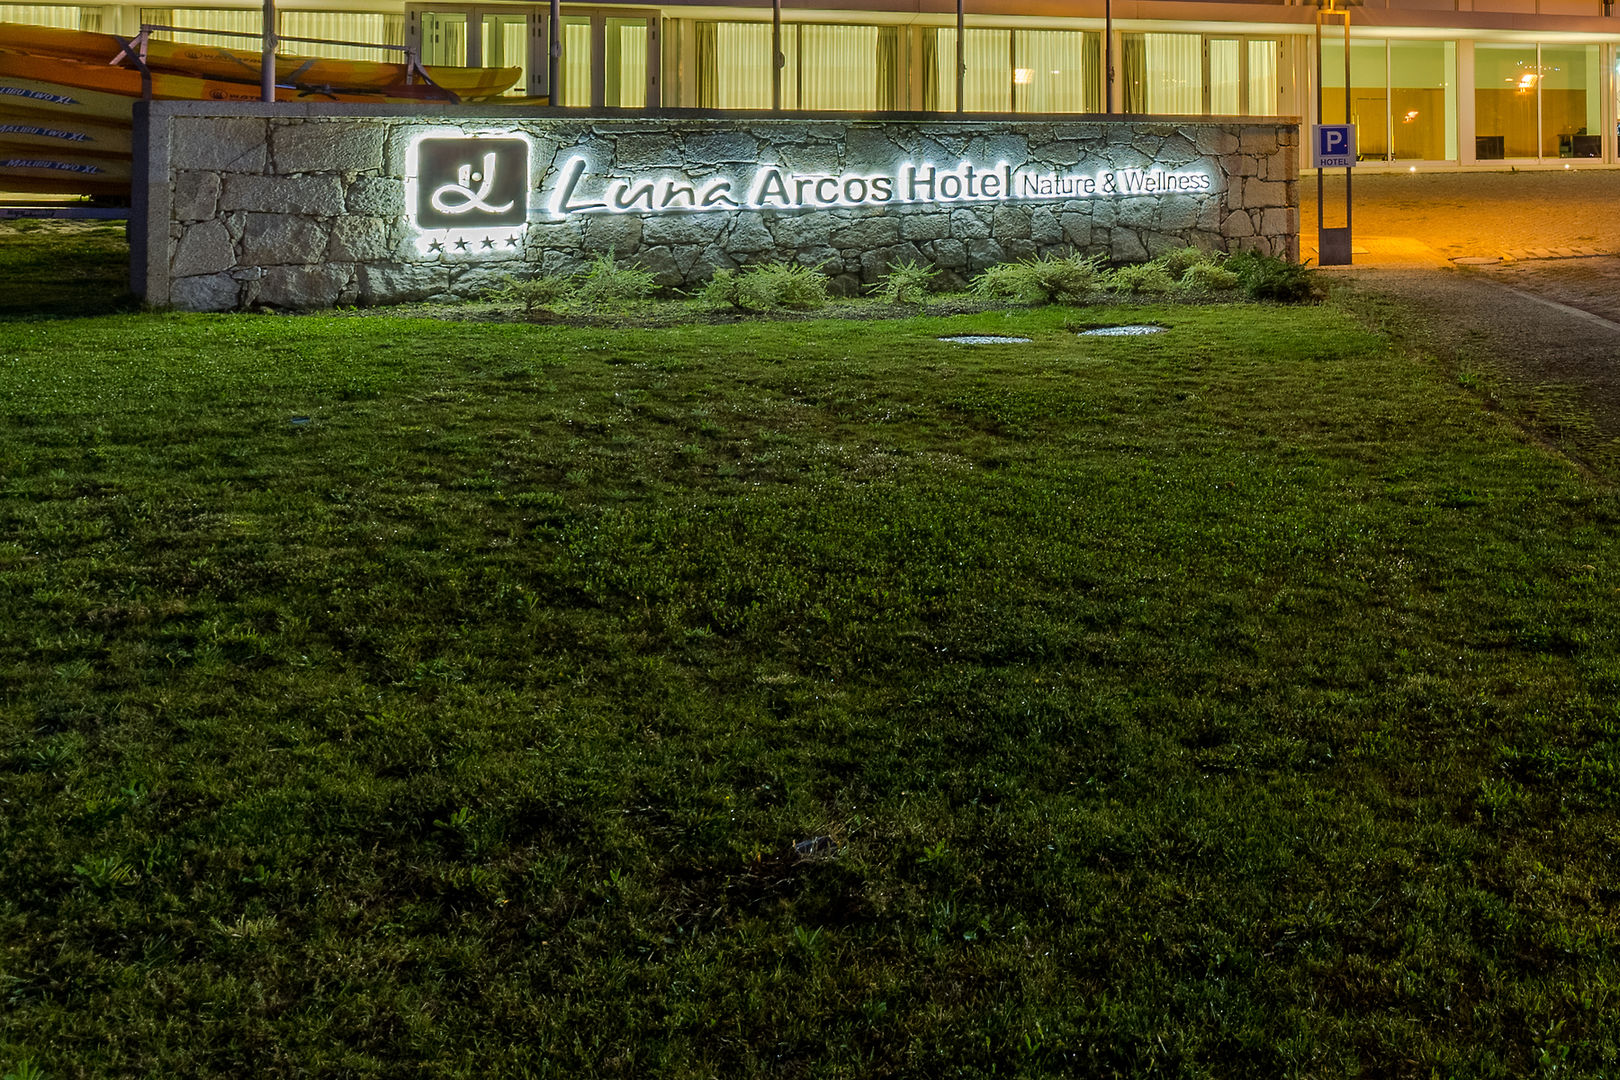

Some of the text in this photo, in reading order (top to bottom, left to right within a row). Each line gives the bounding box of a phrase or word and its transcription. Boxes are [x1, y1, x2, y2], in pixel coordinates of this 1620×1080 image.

[0, 87, 73, 105] LIBU TWO XL
[69, 133, 86, 142] XL
[1327, 131, 1342, 152] P
[1320, 158, 1349, 166] HOTEL
[82, 165, 98, 174] XL
[557, 159, 1211, 213] Luna Arcos Hotel Nature & Wellness
